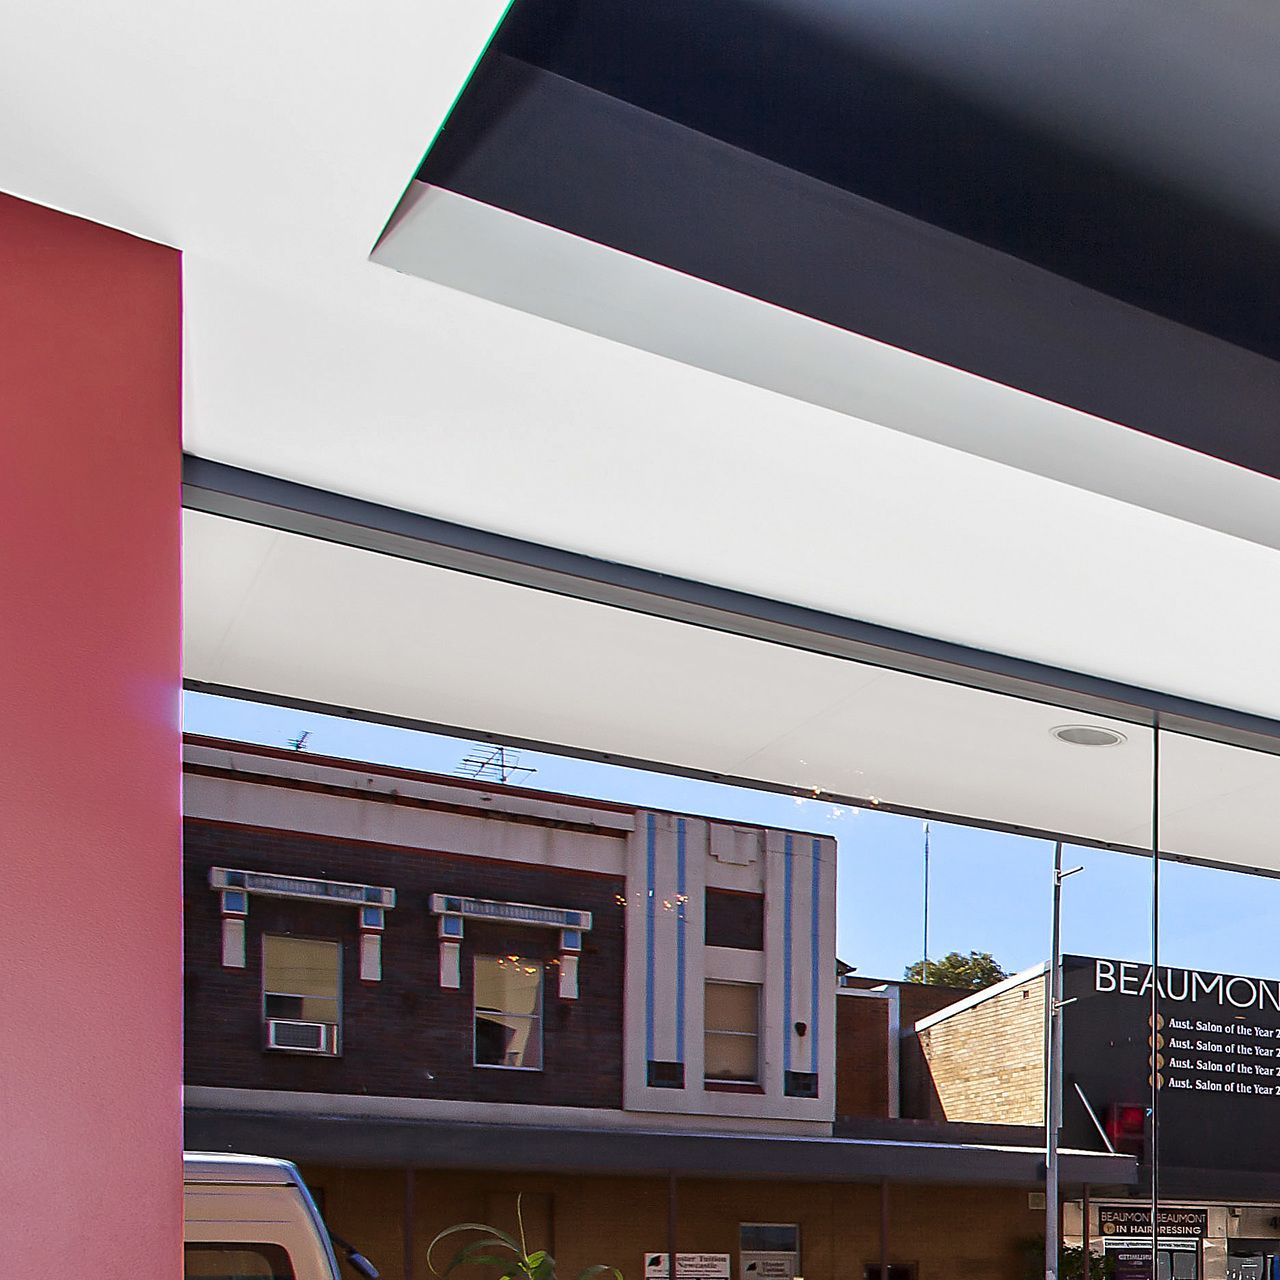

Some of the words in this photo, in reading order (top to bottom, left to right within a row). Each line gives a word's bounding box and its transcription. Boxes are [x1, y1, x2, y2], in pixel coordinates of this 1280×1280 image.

[1169, 1018, 1194, 1030] Aust.
[1196, 1021, 1222, 1032] Salon
[1224, 1024, 1235, 1034] of
[1236, 1025, 1252, 1036] the
[1254, 1026, 1274, 1038] Year
[1169, 1038, 1194, 1049] Aust.
[1196, 1040, 1222, 1052] Salon
[1224, 1044, 1235, 1053] of
[1236, 1044, 1252, 1055] the
[1254, 1046, 1274, 1057] Year
[1170, 1057, 1194, 1068] Aust.
[1196, 1060, 1222, 1072] Salon
[1225, 1063, 1236, 1072] of
[1237, 1064, 1252, 1074] the
[1254, 1066, 1274, 1076] Year
[1168, 1077, 1194, 1088] Aust.
[1196, 1080, 1222, 1092] Salon
[1224, 1083, 1234, 1092] of
[1236, 1084, 1252, 1094] the
[1254, 1086, 1274, 1096] Year
[1101, 1212, 1156, 1222] BEAUMON
[1116, 1225, 1128, 1233] IN
[1130, 1225, 1202, 1235] HAIRRESSING
